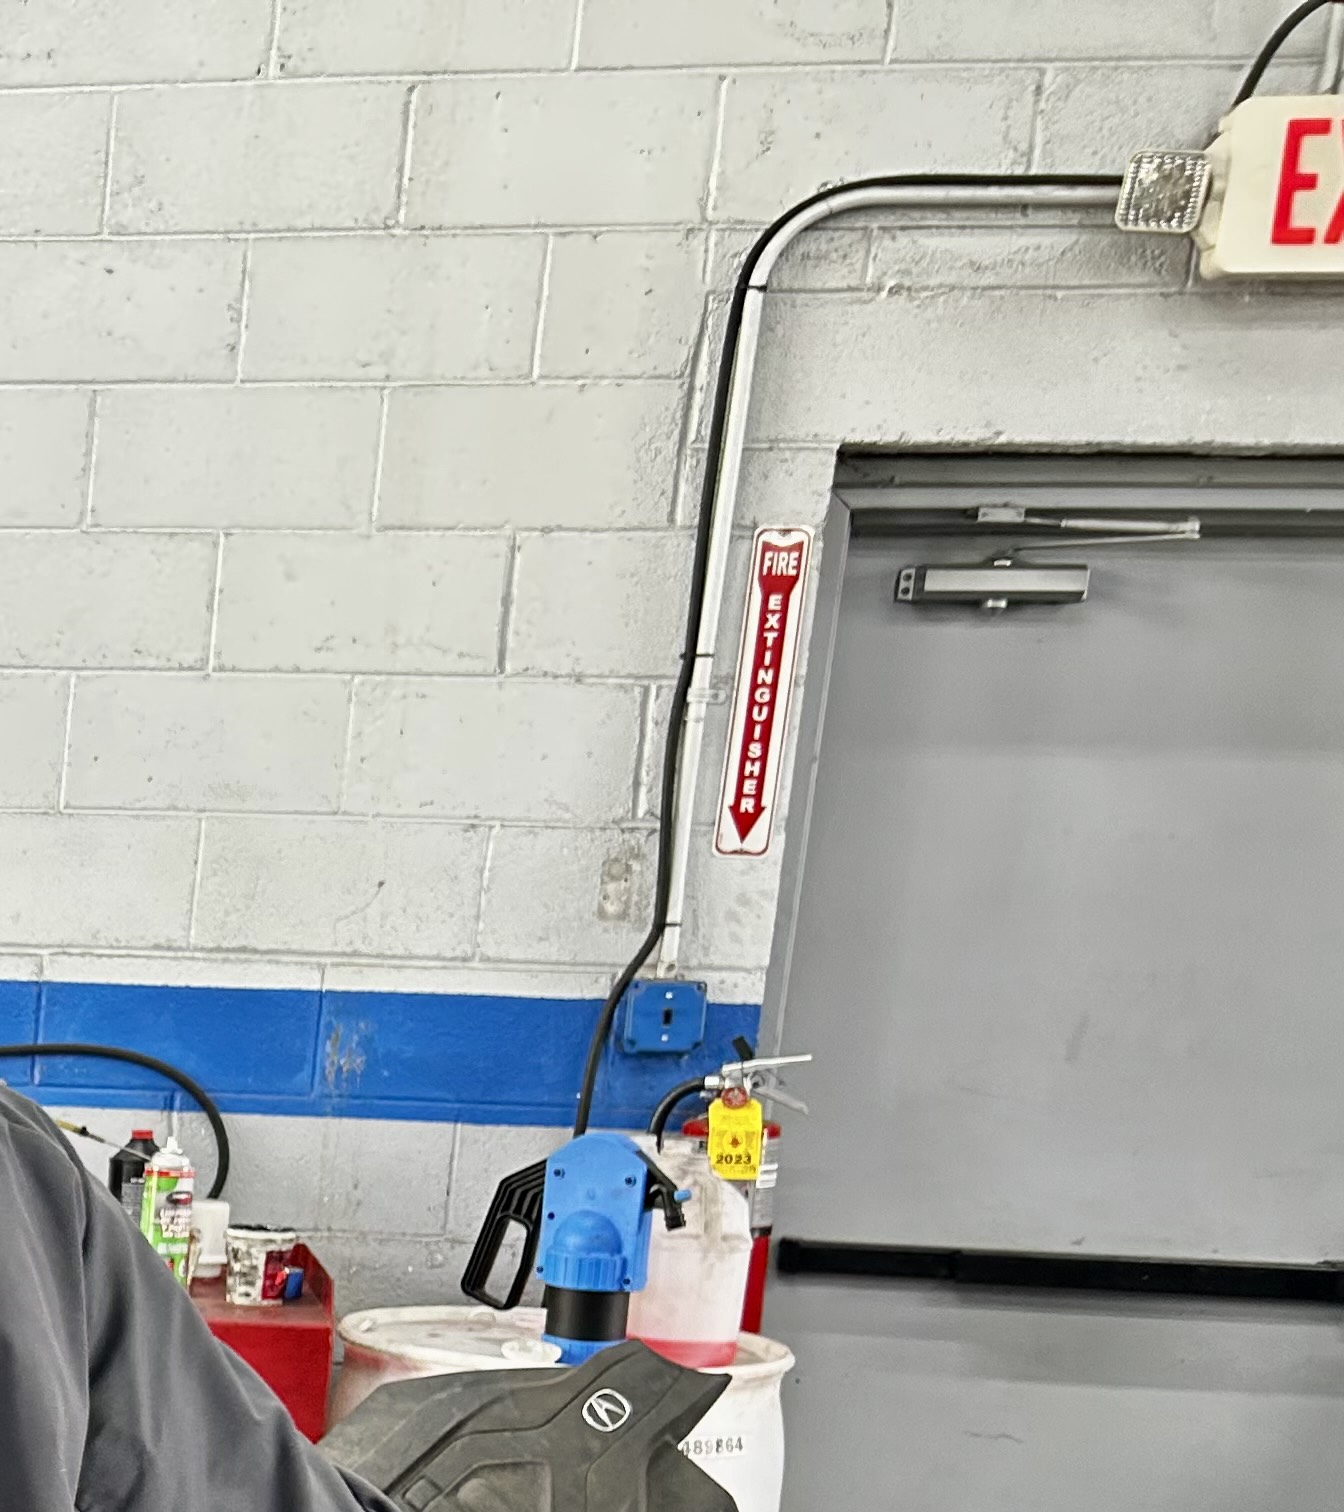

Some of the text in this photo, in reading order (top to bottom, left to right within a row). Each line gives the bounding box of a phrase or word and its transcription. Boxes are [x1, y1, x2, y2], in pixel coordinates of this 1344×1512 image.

[762, 551, 800, 577] FIRE
[739, 592, 784, 814] EXTINGUISHER
[716, 1153, 752, 1165] 2023
